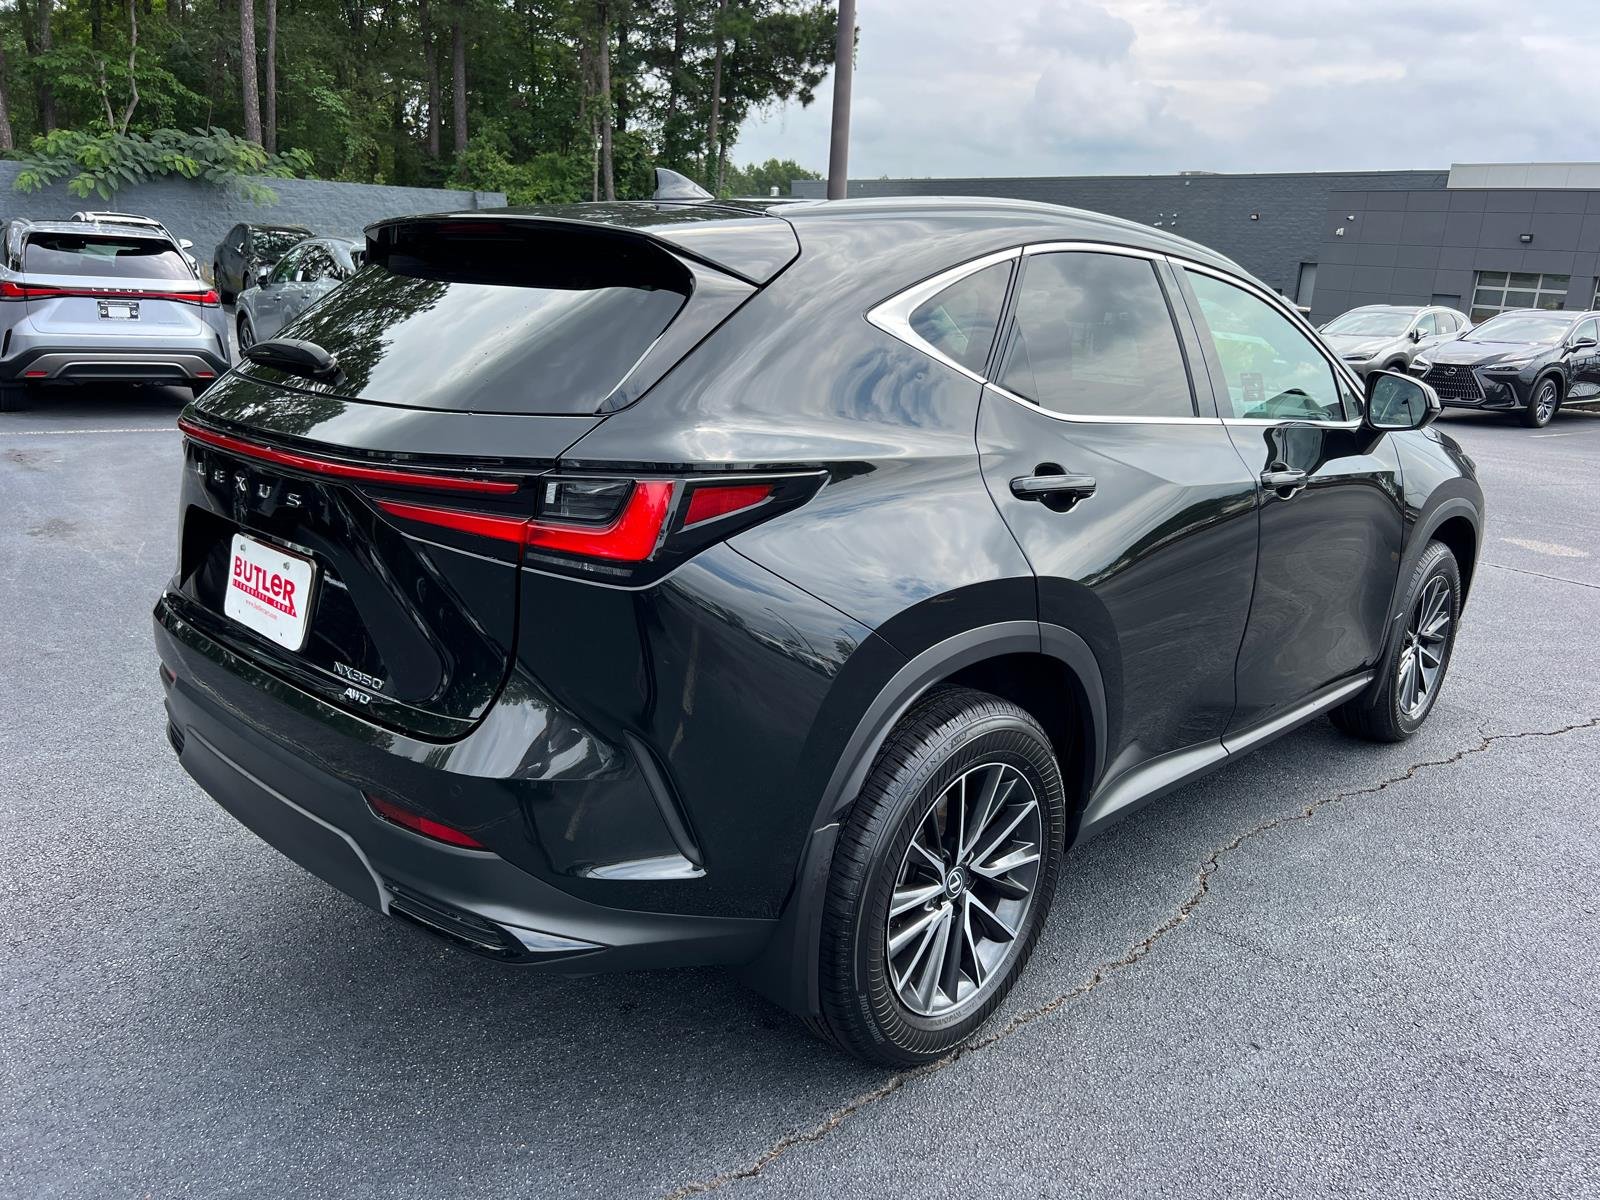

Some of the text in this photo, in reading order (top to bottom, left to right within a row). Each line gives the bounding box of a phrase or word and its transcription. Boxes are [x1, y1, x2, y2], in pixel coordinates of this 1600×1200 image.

[198, 462, 302, 508] LEXUS
[333, 661, 383, 690] NX350
[344, 687, 371, 704] AWD
